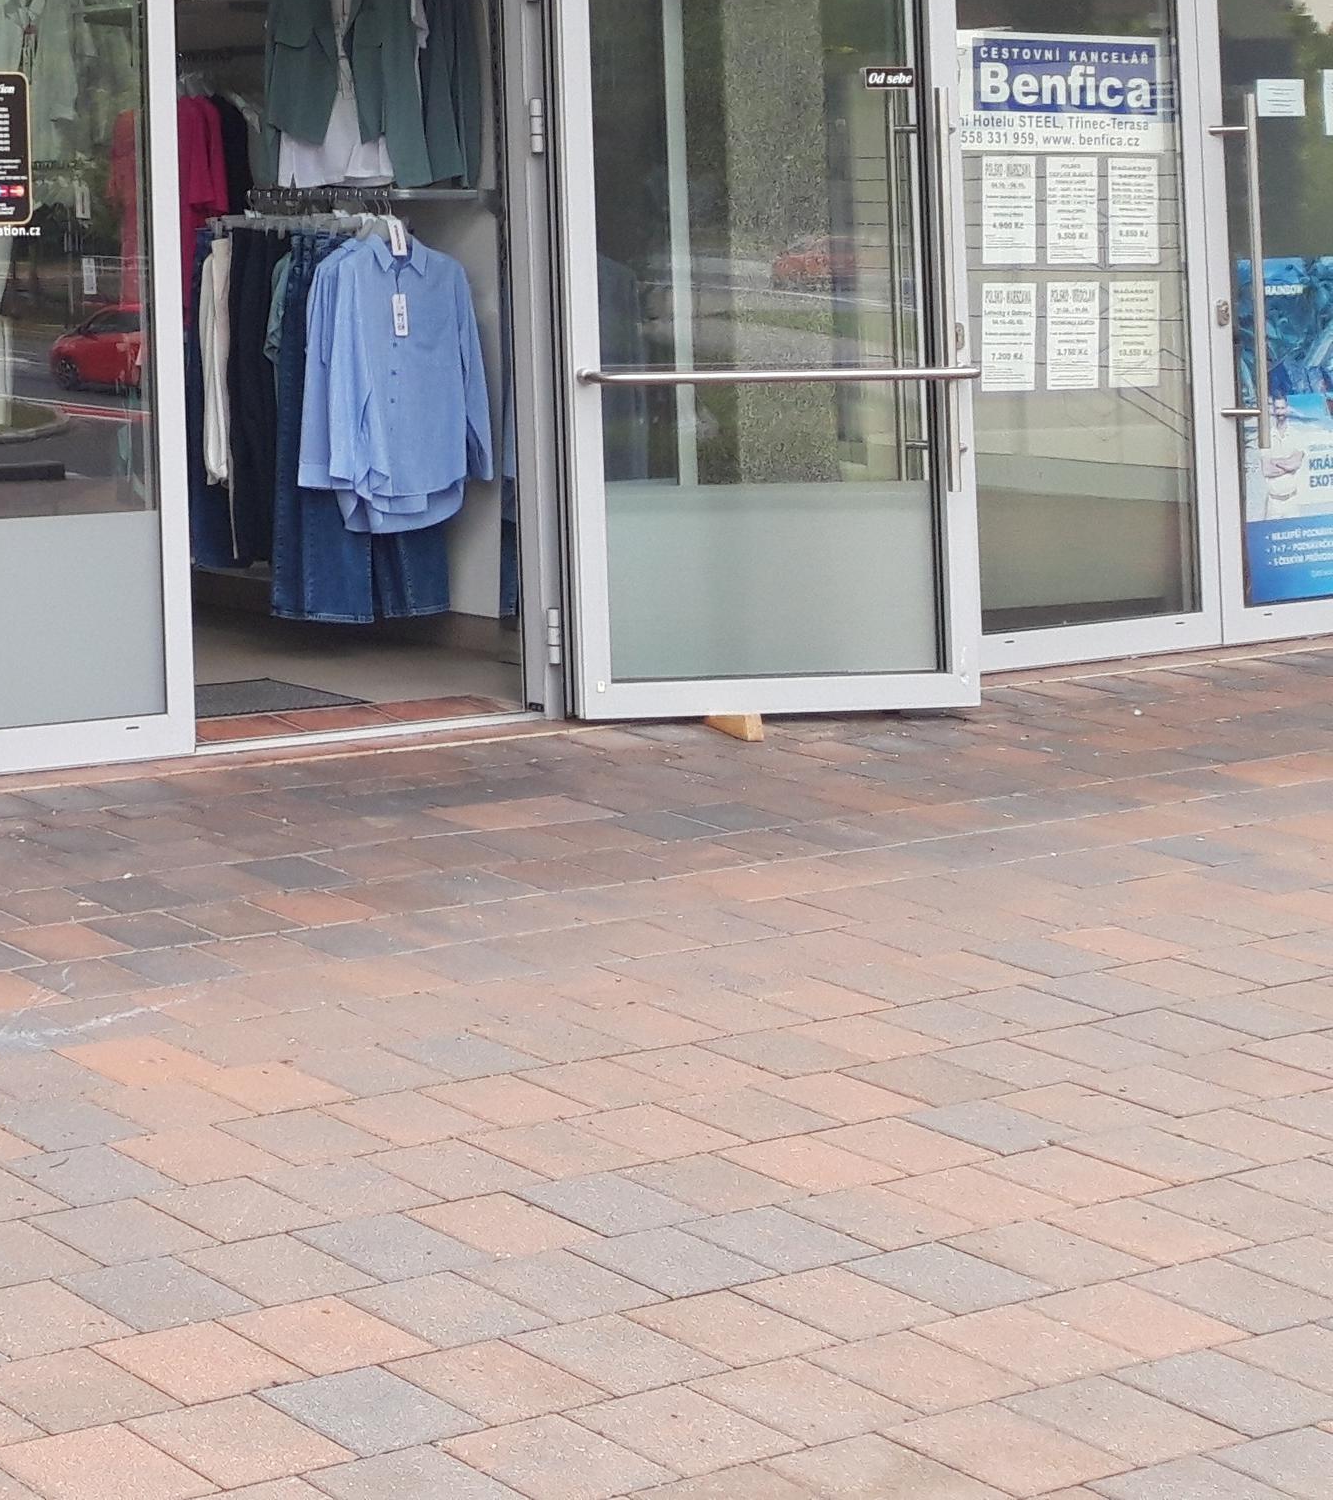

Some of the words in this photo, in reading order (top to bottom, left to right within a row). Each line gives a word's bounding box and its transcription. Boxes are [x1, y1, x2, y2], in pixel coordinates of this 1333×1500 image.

[980, 46, 1060, 60] CESTOVNÍ
[1068, 50, 1149, 64] KANCELÁŘ
[867, 72, 884, 84] Od
[886, 72, 913, 85] sebe
[979, 62, 1151, 108] Benfica
[973, 114, 1015, 129] Hotelu
[1019, 115, 1064, 131] STEEL,
[1067, 114, 1149, 131] Třinec-Terasa
[961, 130, 984, 144] 558
[987, 130, 1009, 145] 331
[1012, 131, 1039, 147] 959,
[1079, 132, 1140, 147] benfica.cz
